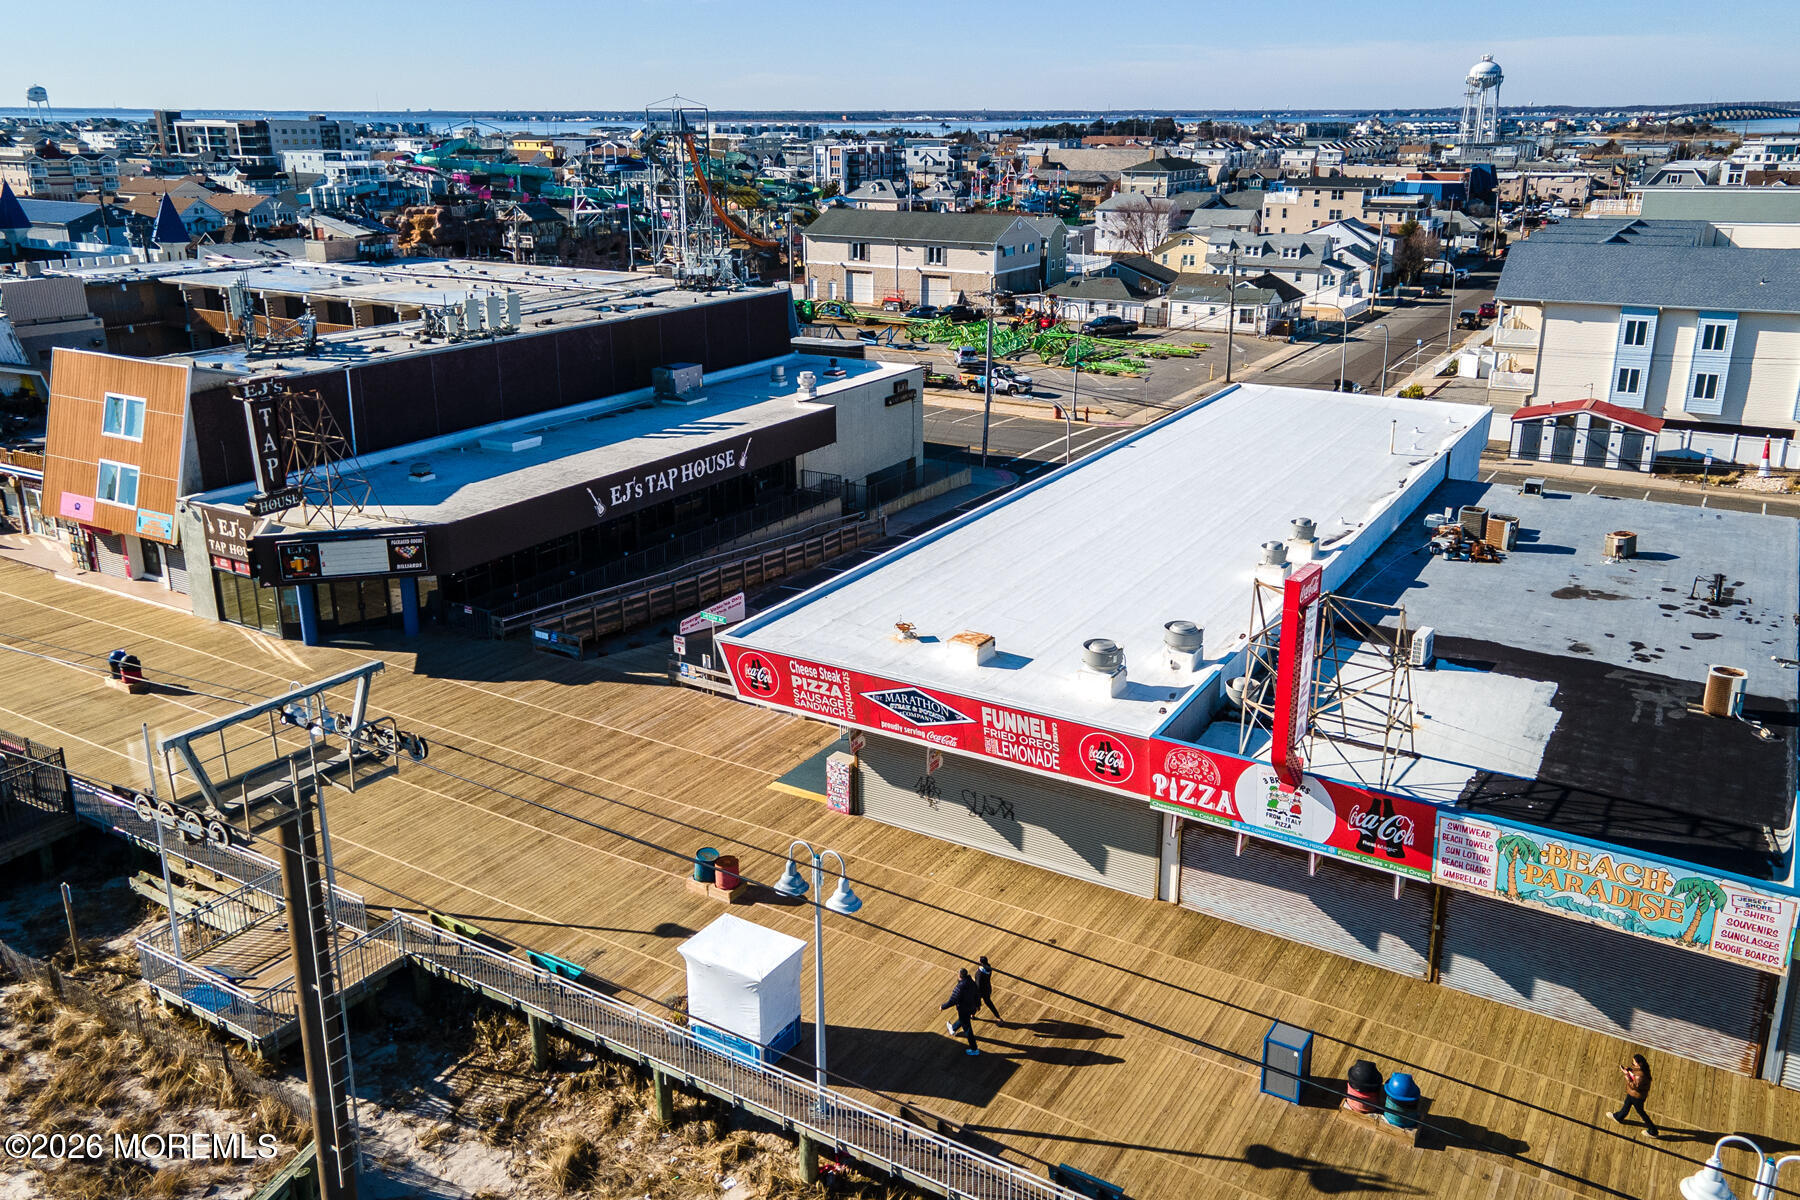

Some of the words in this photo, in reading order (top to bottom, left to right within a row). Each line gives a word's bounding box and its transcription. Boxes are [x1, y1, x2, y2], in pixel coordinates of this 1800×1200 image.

[243, 377, 283, 398] EJ's
[258, 407, 279, 482] TAP
[610, 476, 643, 506] EJ's
[645, 467, 678, 493] TAP
[681, 449, 735, 483] HOUSE
[259, 494, 300, 513] HOUSE
[217, 518, 247, 540] EJ's
[208, 538, 226, 554] TAP
[229, 543, 249, 558] HOU
[789, 660, 818, 678] Cheese
[818, 666, 842, 684] Steak
[791, 675, 843, 699] PIZZA
[842, 671, 857, 720] stromboli
[792, 688, 844, 708] SAUSAGE
[794, 698, 846, 717] SANDWICH
[885, 693, 949, 717] MARATHON
[902, 710, 934, 722] COMPANY
[981, 706, 1052, 741] FUNNEL
[881, 720, 903, 732] proudly
[903, 726, 926, 738] serving
[983, 727, 1017, 742] FRIED
[1019, 735, 1060, 752] OREOS
[995, 739, 1061, 771] LEMONADE
[1152, 773, 1236, 816] PIZZA
[1199, 813, 1213, 821] Cold
[1214, 816, 1230, 826] Subs
[1265, 811, 1282, 821] FROM
[1285, 816, 1302, 826] ITALY
[1274, 820, 1292, 829] PIZZA
[1347, 804, 1415, 846] Coca-Cola
[1447, 822, 1492, 839] SWIMWEAR
[1442, 832, 1464, 844] BEACH
[1465, 838, 1494, 852] TOWELS
[1337, 850, 1361, 861] Funnel
[1361, 856, 1383, 867] Cakes
[1389, 863, 1408, 873] Fried
[1409, 868, 1430, 879] Oreos
[1445, 846, 1460, 856] SUN
[1462, 850, 1490, 863] LOTION
[1441, 856, 1464, 870] BEACH
[1465, 862, 1492, 876] CHAIRS
[1540, 843, 1674, 894] BEACH
[1443, 869, 1488, 888] UMBRELLAS
[1520, 863, 1685, 924] PARADISE
[1734, 907, 1776, 924] T-SHIRTS
[1745, 902, 1773, 912] SHORE
[1726, 917, 1779, 938] SOUVENIRS
[1720, 929, 1780, 951] SUNGLASSES
[1714, 940, 1743, 955] BOOGIE
[1744, 948, 1780, 965] BOARDS
